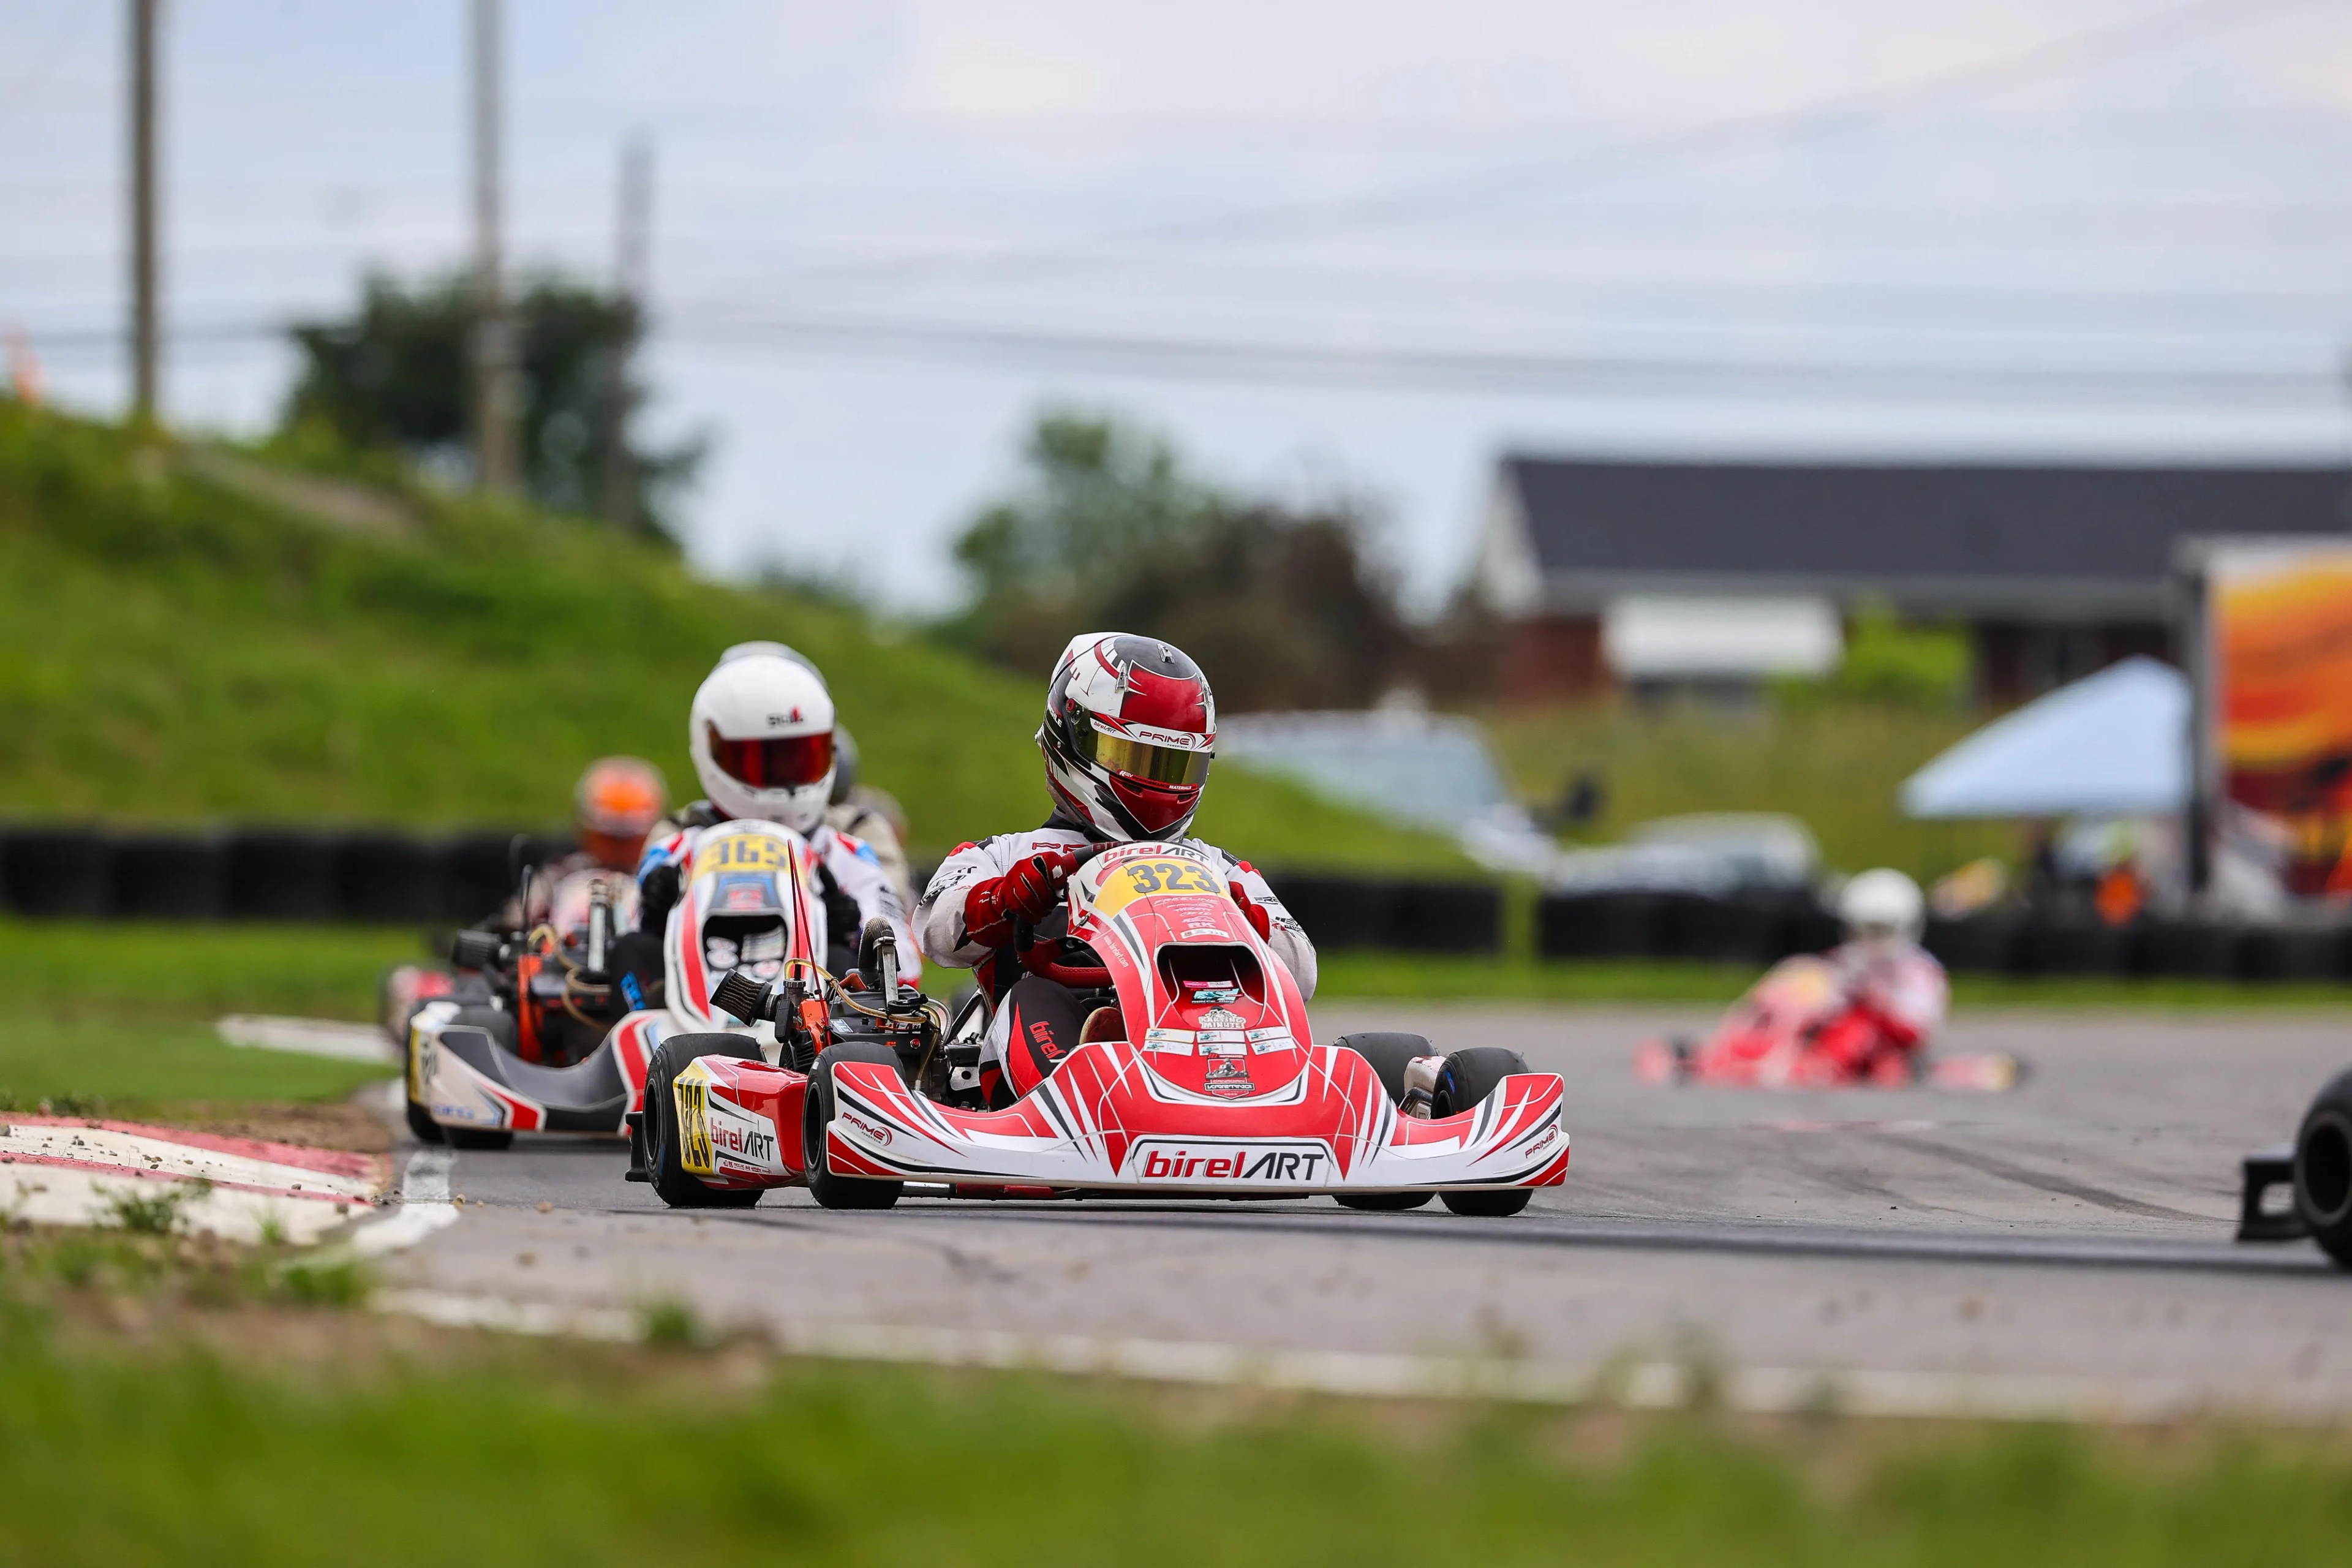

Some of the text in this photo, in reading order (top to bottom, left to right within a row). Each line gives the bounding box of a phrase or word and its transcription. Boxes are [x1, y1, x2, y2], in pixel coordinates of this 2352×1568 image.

[1139, 731, 1190, 745] PRIME
[1103, 845, 1210, 864] birelART
[1128, 863, 1221, 893] 323
[710, 1117, 774, 1162] birelART
[842, 1112, 886, 1141] PRIME
[1525, 1130, 1555, 1159] PRIME
[1142, 1150, 1325, 1181] birelART
